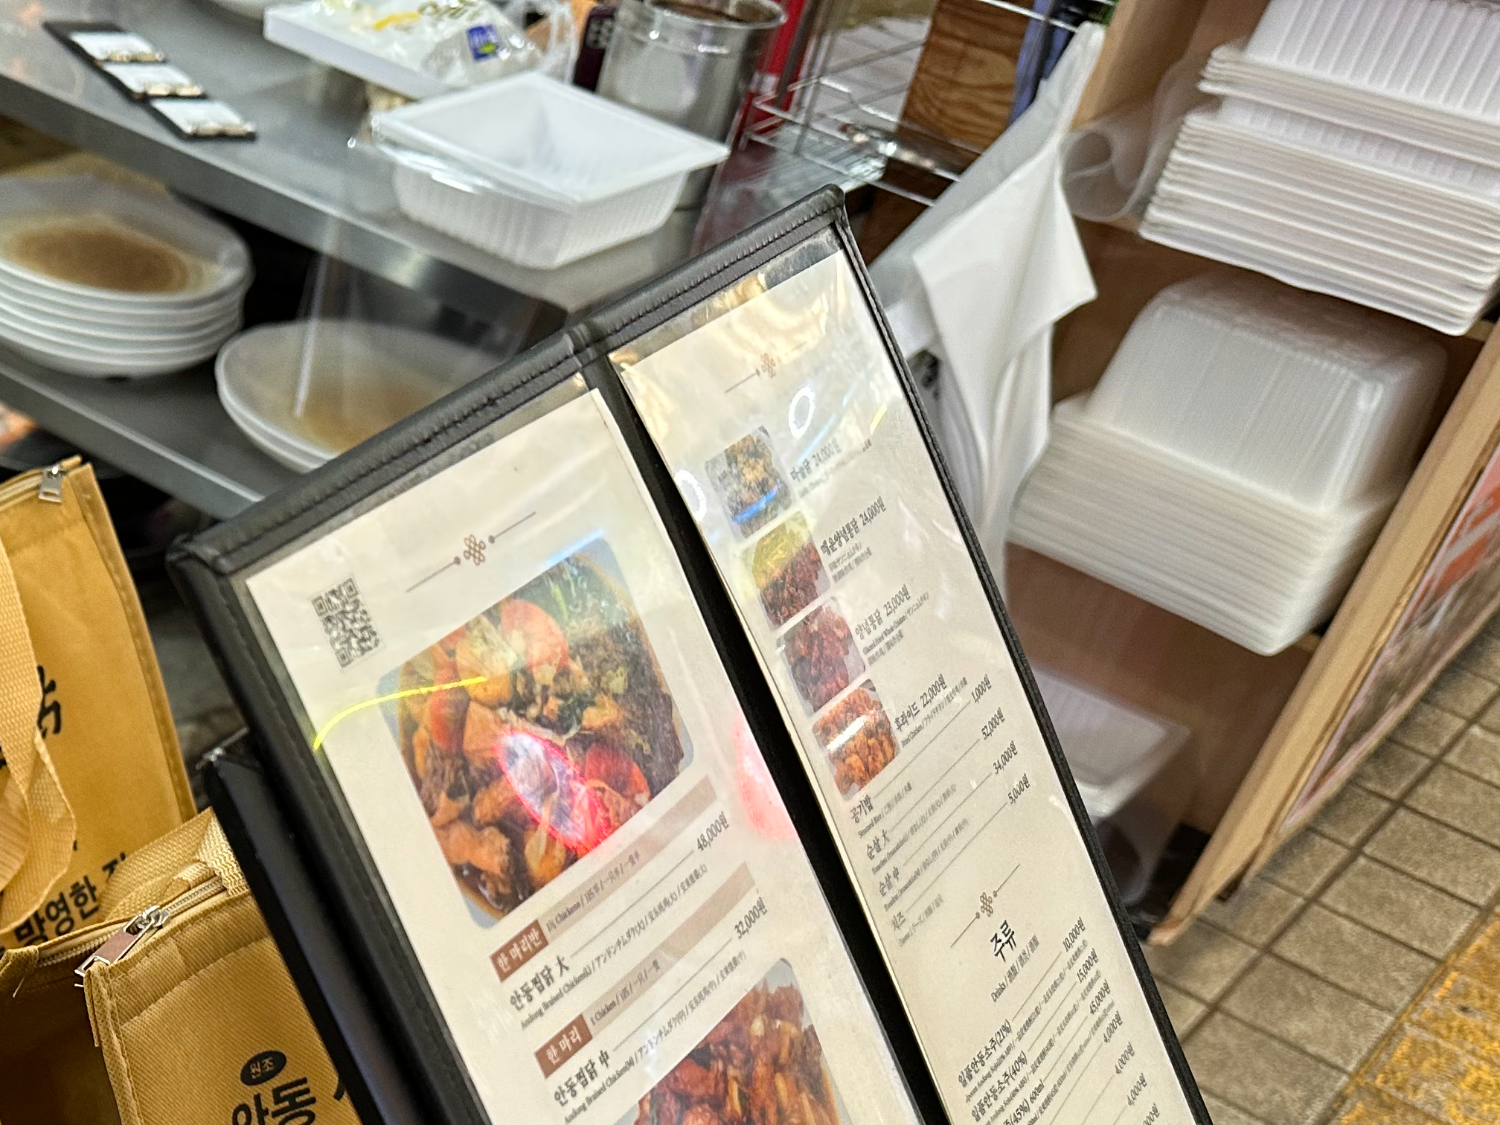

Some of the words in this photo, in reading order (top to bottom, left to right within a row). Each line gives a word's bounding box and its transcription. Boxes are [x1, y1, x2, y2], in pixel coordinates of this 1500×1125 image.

[858, 495, 886, 526] 24,000원
[854, 608, 883, 640] 양념통닭
[882, 582, 911, 617] 23,000원
[893, 701, 920, 732] 후라이드
[918, 672, 947, 708] 22,000원
[850, 793, 874, 824] 공기밥
[970, 673, 992, 703] 1,000원
[865, 835, 882, 861] 순살
[980, 706, 1005, 740] 52,000원
[878, 872, 893, 897] 순살
[992, 739, 1018, 775] 34,000원
[890, 910, 906, 930] 치즈
[1006, 772, 1030, 805] 5,000원
[509, 964, 554, 1011] 안동찜닭
[555, 955, 570, 977] 大
[696, 811, 729, 851] 48,000원
[989, 919, 1017, 962] 주류
[553, 1058, 598, 1106] 안동찜닭
[733, 896, 768, 939] 32,000원
[957, 1019, 1012, 1087] 일품안동소주(21%)
[1061, 916, 1086, 952] 10,000원
[1088, 978, 1111, 1015] 45,000원
[1102, 1010, 1123, 1043] 4,000원
[545, 1043, 560, 1065] 한
[557, 1025, 582, 1051] 마리
[970, 1050, 1028, 1122] 일품안동소주(40%)
[1075, 947, 1099, 983] 15,000원
[1114, 1041, 1135, 1075] 4,000원
[1126, 1072, 1148, 1106] 4,000원
